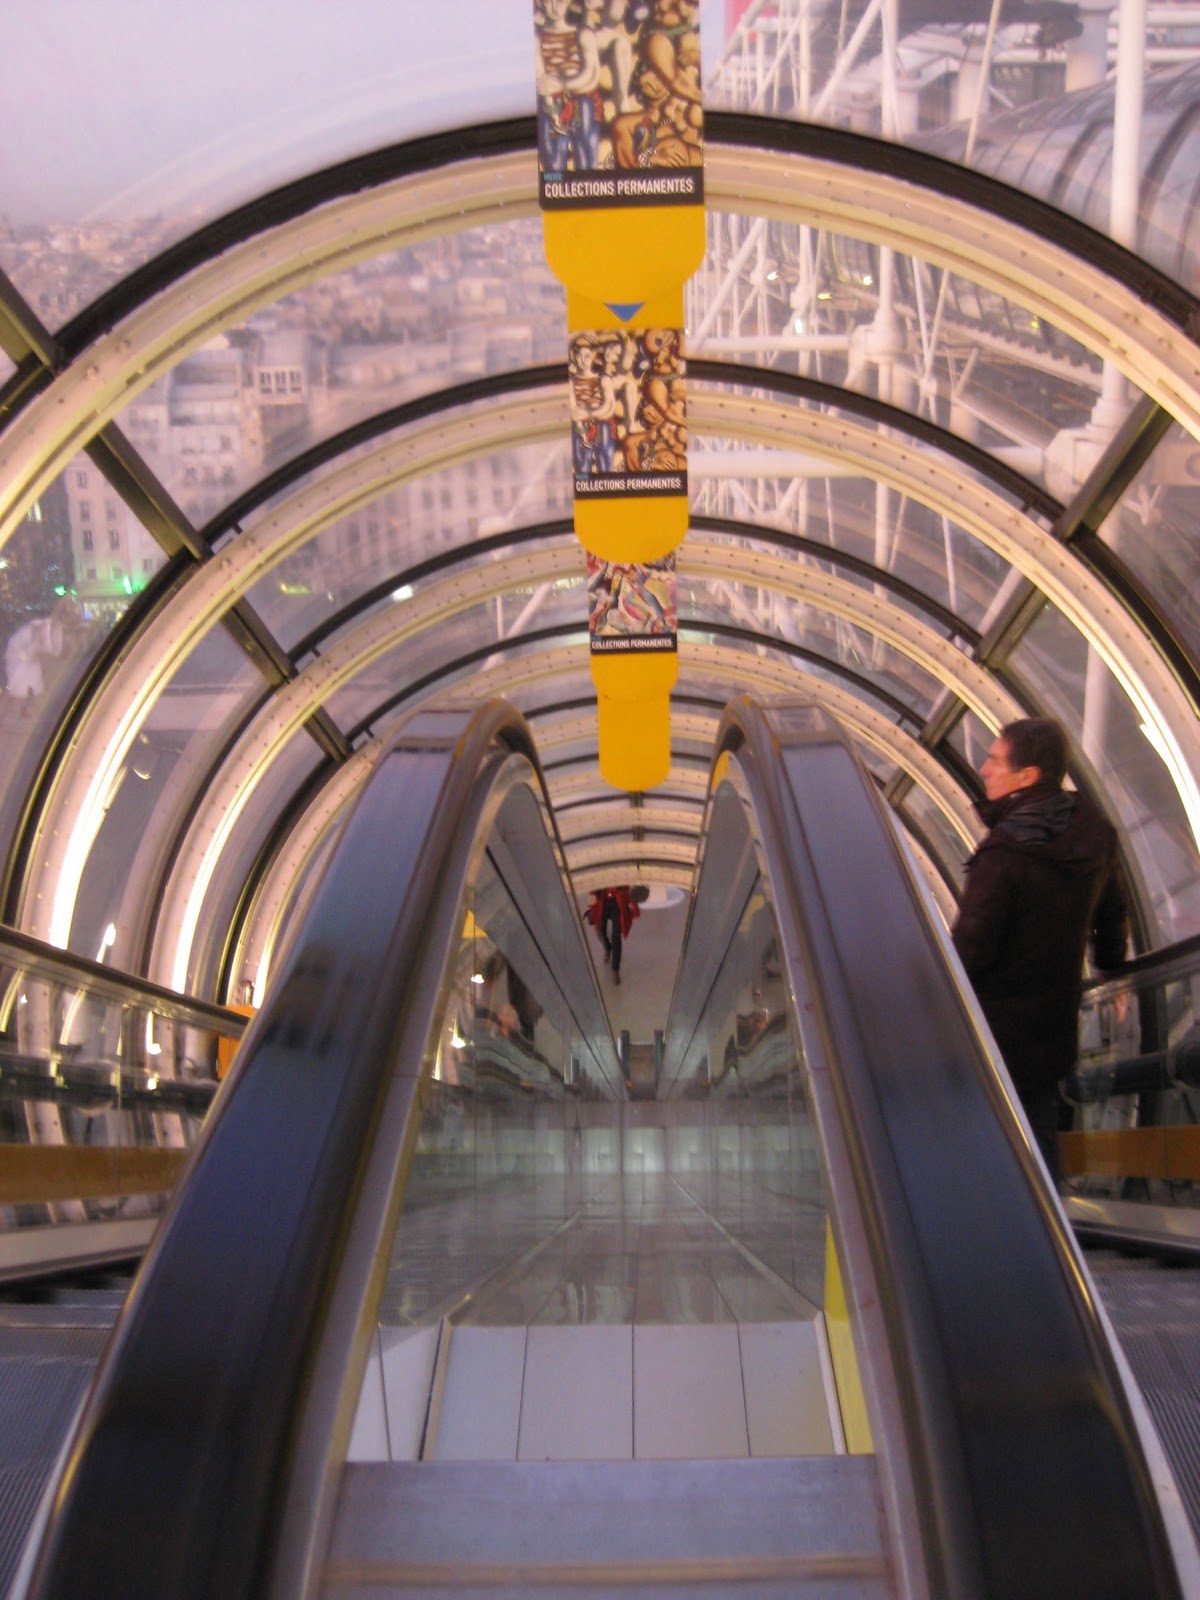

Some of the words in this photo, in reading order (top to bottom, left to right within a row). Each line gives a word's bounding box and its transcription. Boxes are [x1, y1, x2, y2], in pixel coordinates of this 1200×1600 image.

[544, 182, 615, 199] COLLECTIONS
[617, 178, 694, 195] PERMANENTES
[576, 479, 625, 492] COLLECTIONS
[627, 476, 681, 490] PERMANENTES
[592, 640, 630, 650] COLLECTIONS
[630, 638, 673, 649] PERMANENTES
